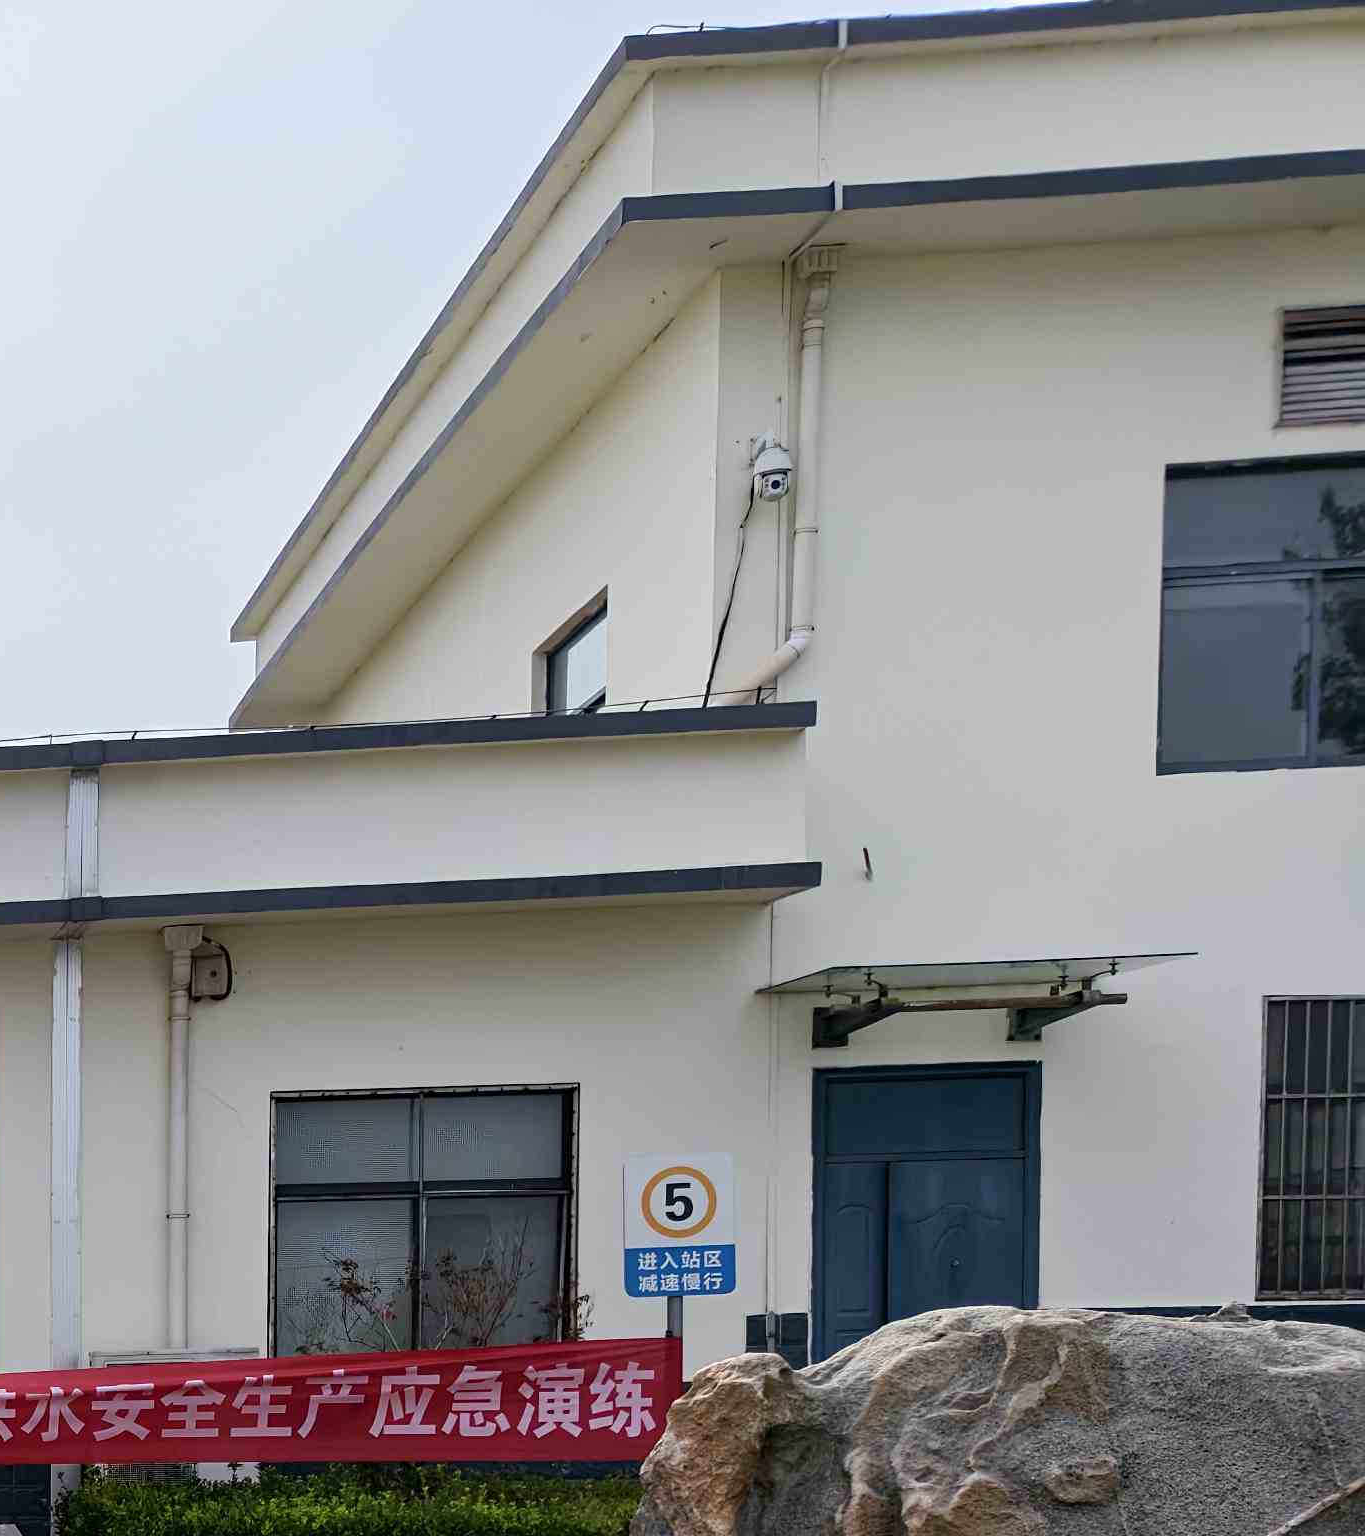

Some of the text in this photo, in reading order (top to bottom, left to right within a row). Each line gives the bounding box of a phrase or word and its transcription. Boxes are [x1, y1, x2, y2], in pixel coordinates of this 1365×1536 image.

[665, 1182, 694, 1221] 5
[638, 1250, 722, 1270] 进入站区
[638, 1272, 723, 1292] 减速慢行
